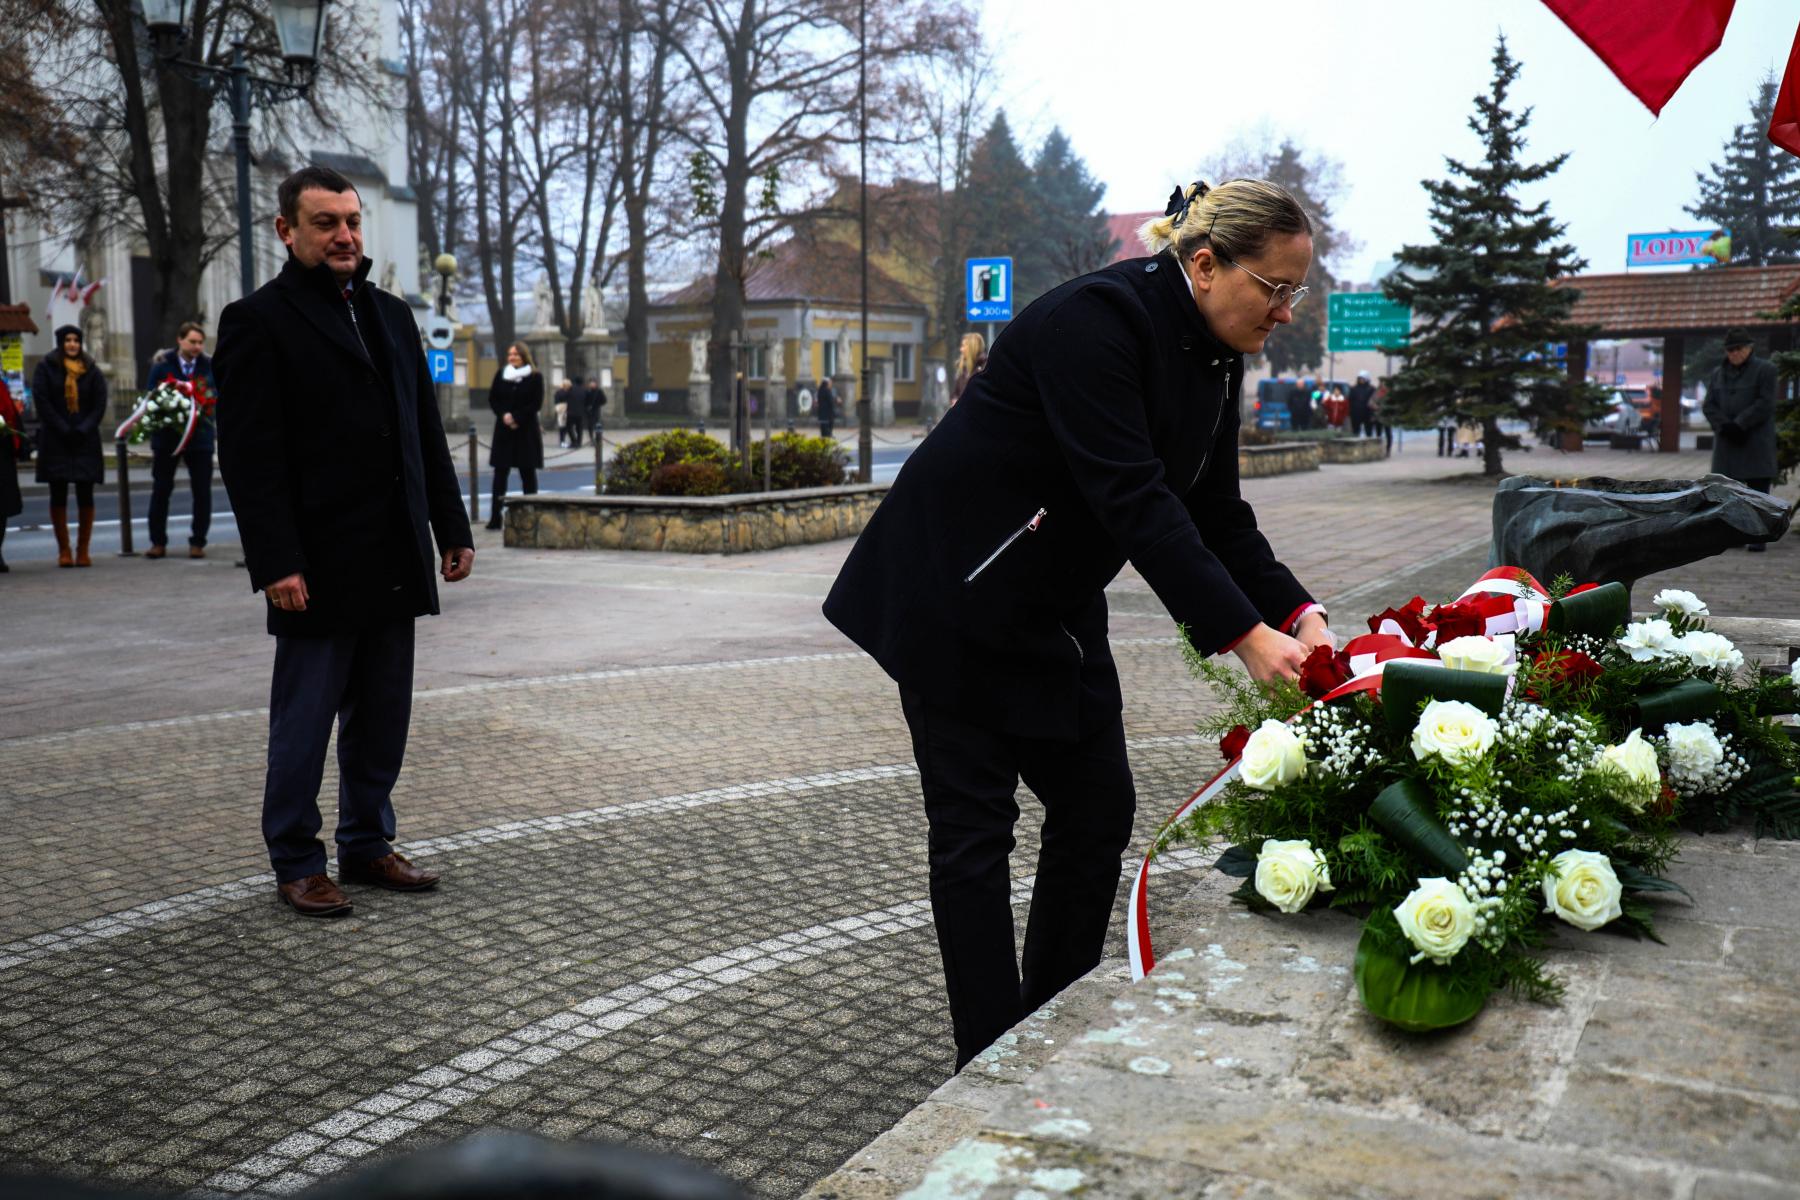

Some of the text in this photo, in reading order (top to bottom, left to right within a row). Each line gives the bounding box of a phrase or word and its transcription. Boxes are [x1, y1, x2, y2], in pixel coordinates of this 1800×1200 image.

[1633, 237, 1702, 257] LODY
[983, 307, 1001, 316] 300
[435, 354, 448, 378] P
